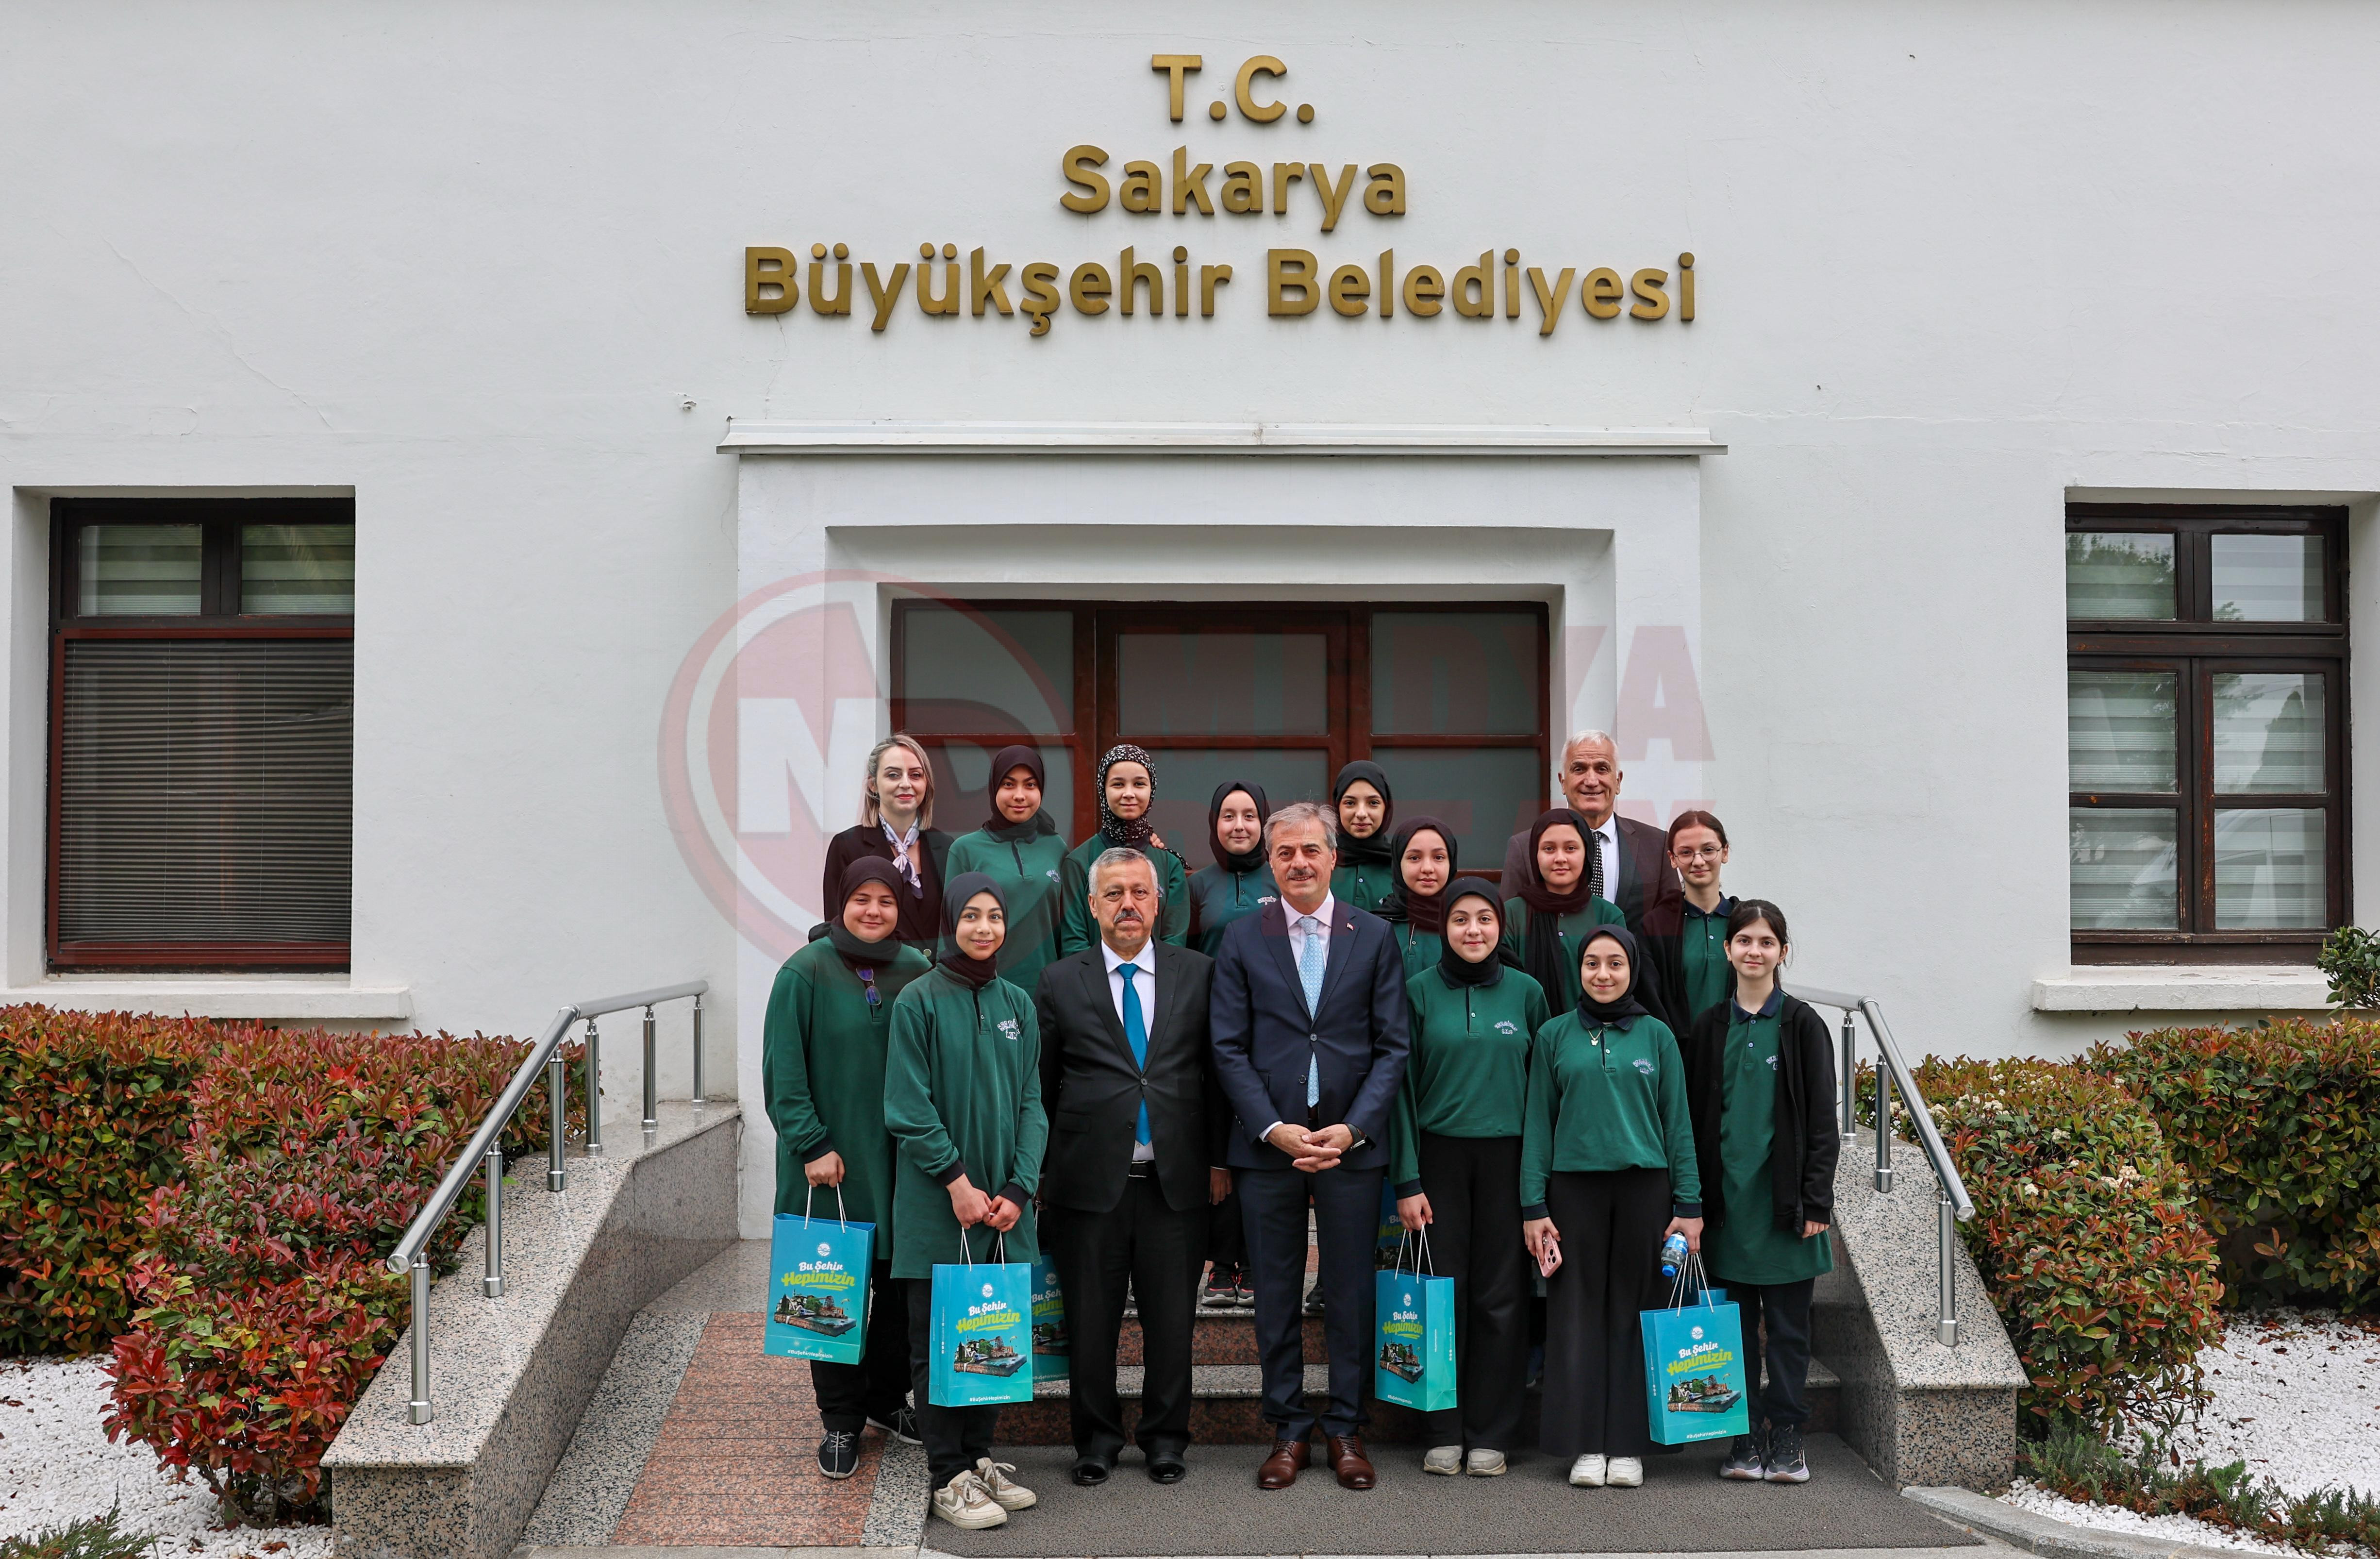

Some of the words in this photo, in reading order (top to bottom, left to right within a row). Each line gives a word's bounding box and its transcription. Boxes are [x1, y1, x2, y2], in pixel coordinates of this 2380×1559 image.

[1151, 54, 1315, 122] T.C.
[1060, 145, 1407, 232] Sakarya
[745, 242, 1233, 336] Büyükşehir
[1267, 248, 1696, 335] Belediyesi
[799, 1262, 814, 1272] Bu
[815, 1261, 843, 1273] Şehir
[781, 1270, 855, 1287] Hepimizin
[1031, 1293, 1044, 1303] Bu
[1045, 1289, 1062, 1301] Şeh
[968, 1305, 981, 1316] Bu
[981, 1301, 1007, 1315] Şehir
[1393, 1312, 1402, 1321] Bu
[1402, 1310, 1418, 1322] Şehir
[955, 1309, 1021, 1334] Hepimizin
[1382, 1319, 1423, 1335] Hepimizin
[787, 1349, 833, 1359] #BuŞehirHepimizin
[1679, 1348, 1692, 1358] Bu
[1692, 1341, 1718, 1356] Şehir
[1666, 1349, 1733, 1376] Hepimizin
[969, 1394, 1010, 1403] #BuŞehirHepimizin
[1686, 1429, 1727, 1439] #BuŞehirHepimizin
